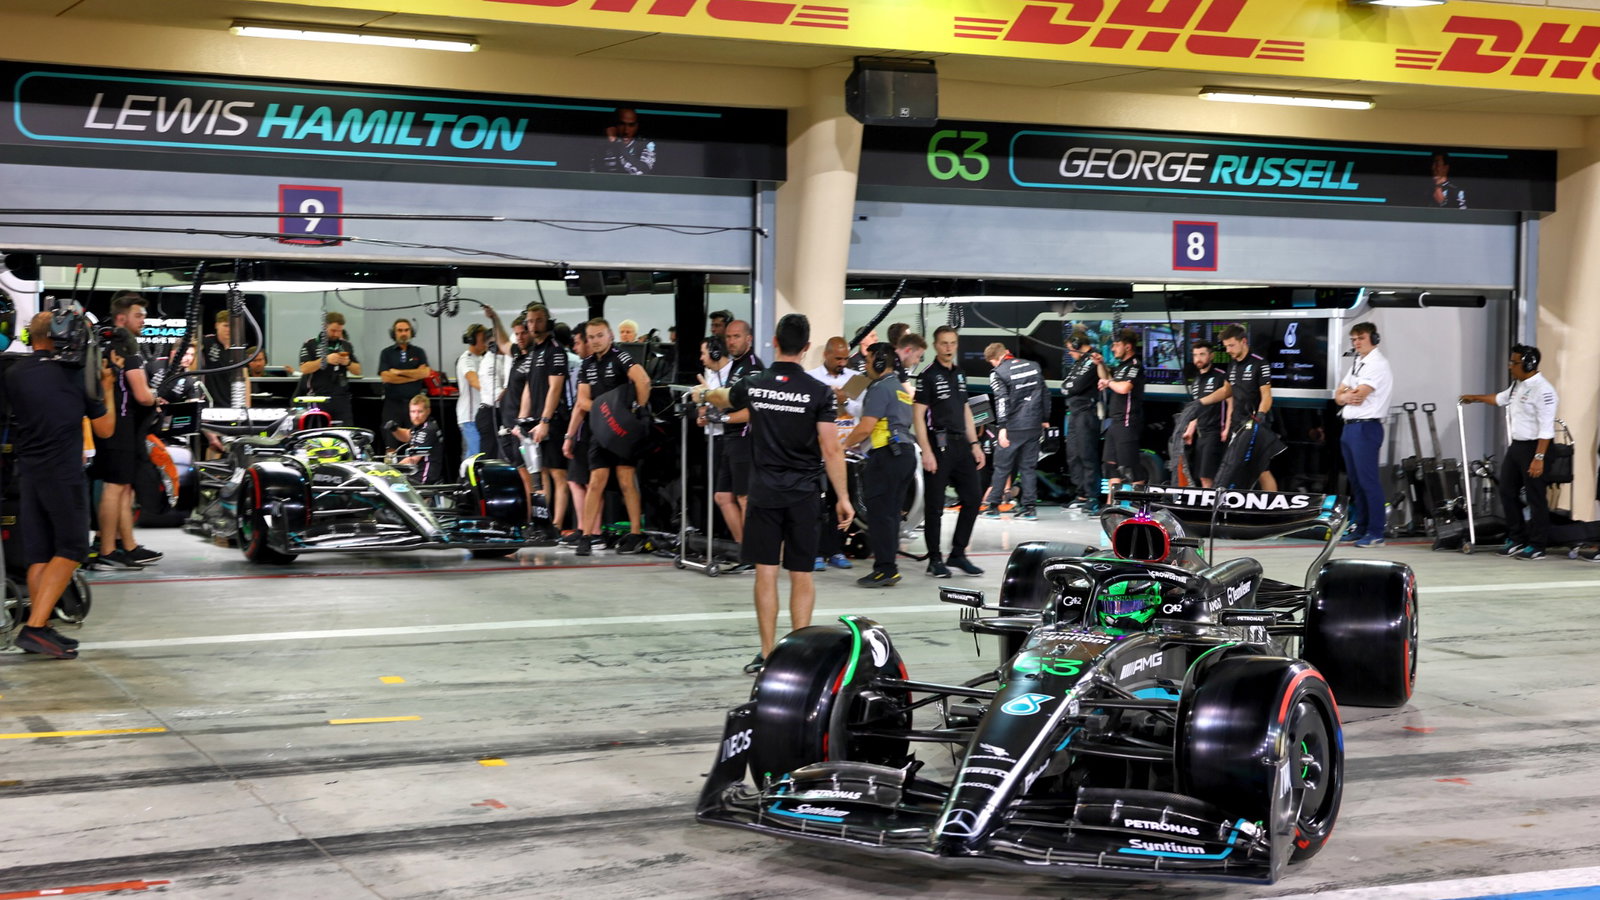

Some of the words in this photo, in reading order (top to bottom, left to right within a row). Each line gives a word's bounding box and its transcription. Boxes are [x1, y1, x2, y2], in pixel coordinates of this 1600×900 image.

[1003, 0, 1261, 57] DHL
[1437, 15, 1600, 80] DH
[84, 93, 255, 136] LEWIS
[257, 103, 528, 151] HAMILTON
[926, 130, 990, 181] 63
[1059, 147, 1209, 183] GEORGE
[1209, 155, 1359, 190] RUSSELL
[299, 198, 325, 232] 9
[1186, 231, 1205, 261] 8
[748, 387, 811, 403] PETRONAS
[1013, 656, 1083, 676] 63
[1131, 652, 1163, 675] AMG
[720, 729, 753, 763] INEOS
[803, 789, 862, 800] PETRONAS
[789, 803, 850, 818] Syntium
[1124, 819, 1200, 836] PETRONAS
[1128, 838, 1206, 854] Syntium
